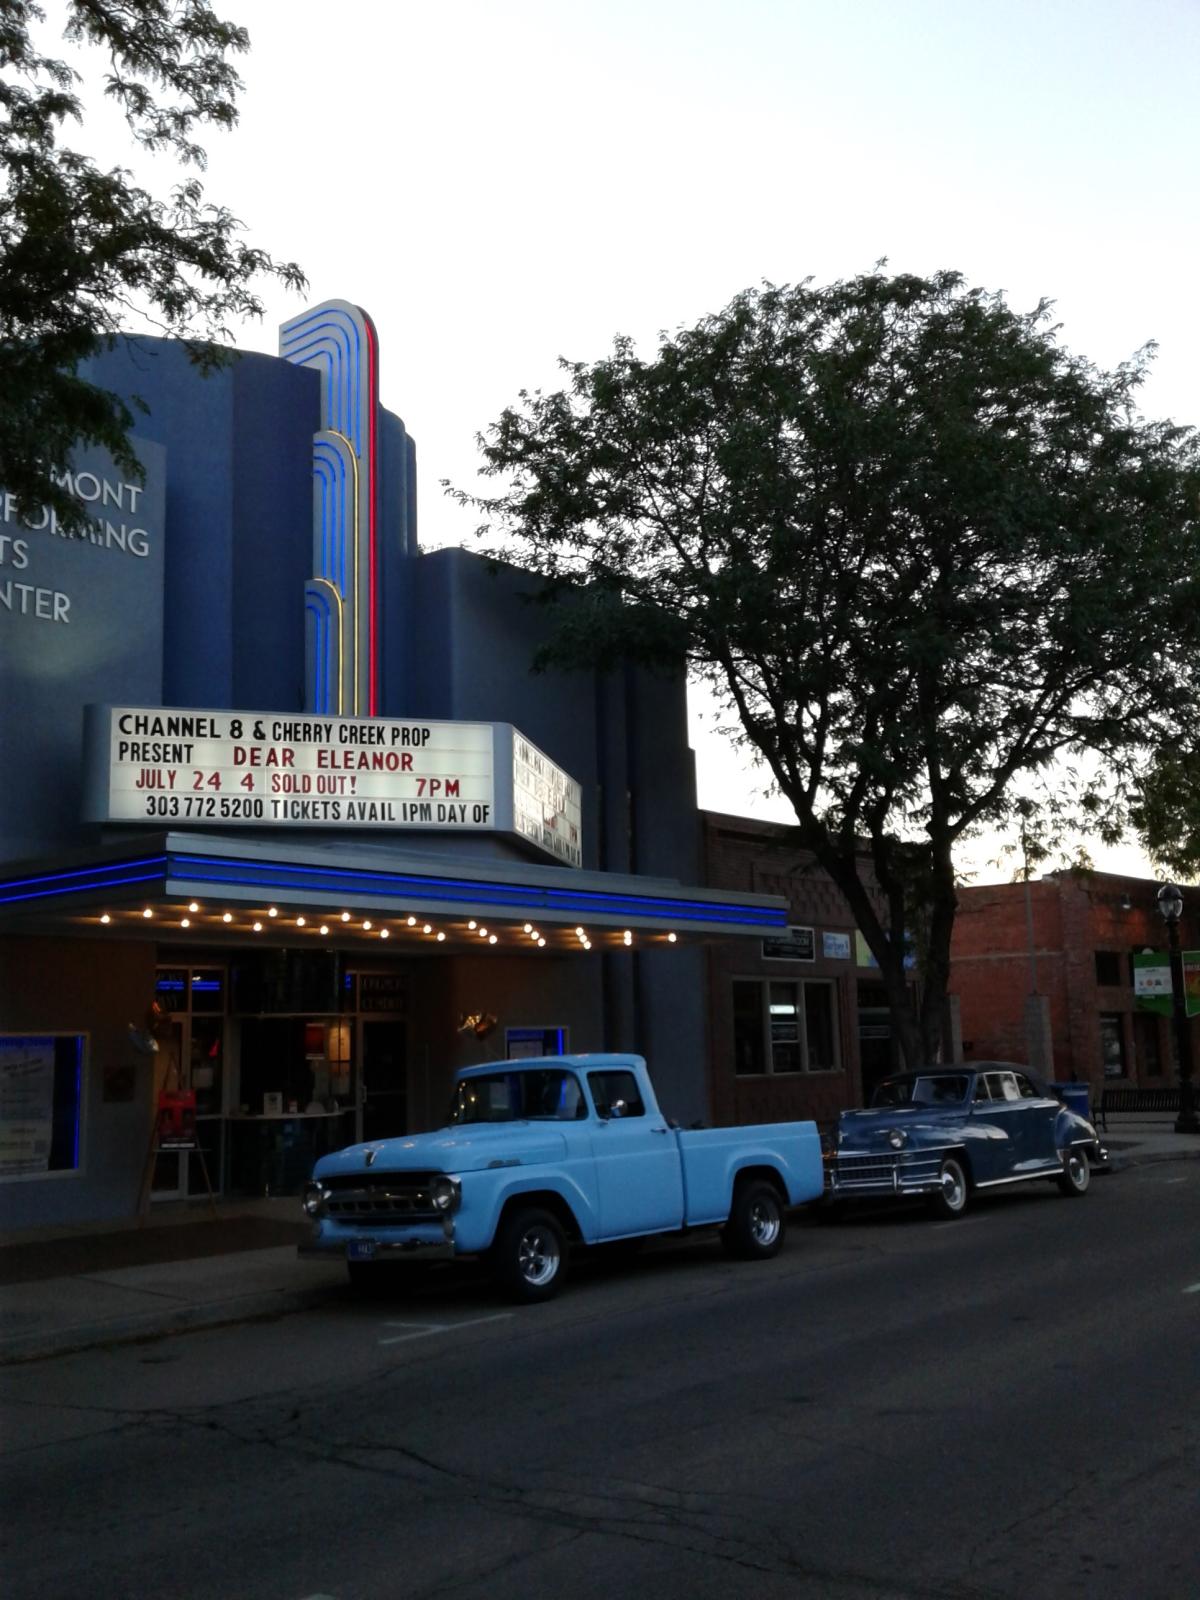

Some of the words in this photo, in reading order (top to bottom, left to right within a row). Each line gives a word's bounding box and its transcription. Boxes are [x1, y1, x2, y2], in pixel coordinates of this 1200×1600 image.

[37, 459, 143, 513] MONT
[119, 715, 221, 738] CHANNEL
[230, 720, 243, 739] 8
[253, 721, 266, 740] &
[272, 722, 332, 744] CHERRY
[340, 724, 385, 745] CREEK
[392, 727, 431, 747] PROP
[119, 741, 194, 763] PRESENT
[234, 746, 295, 767] DEAR
[317, 750, 414, 771] ELEANOR
[136, 769, 177, 789] JULY
[193, 771, 222, 791] 24
[240, 773, 255, 792] 4
[271, 773, 311, 794] SOLD
[317, 775, 357, 795] OUT!
[416, 778, 460, 797] 7PM
[146, 796, 179, 816] 303
[184, 797, 216, 817] 772
[221, 798, 263, 818] 5200
[271, 799, 340, 820] TICKETS
[346, 802, 395, 821] AVAIL
[437, 804, 467, 823] DAY
[473, 805, 490, 823] OF
